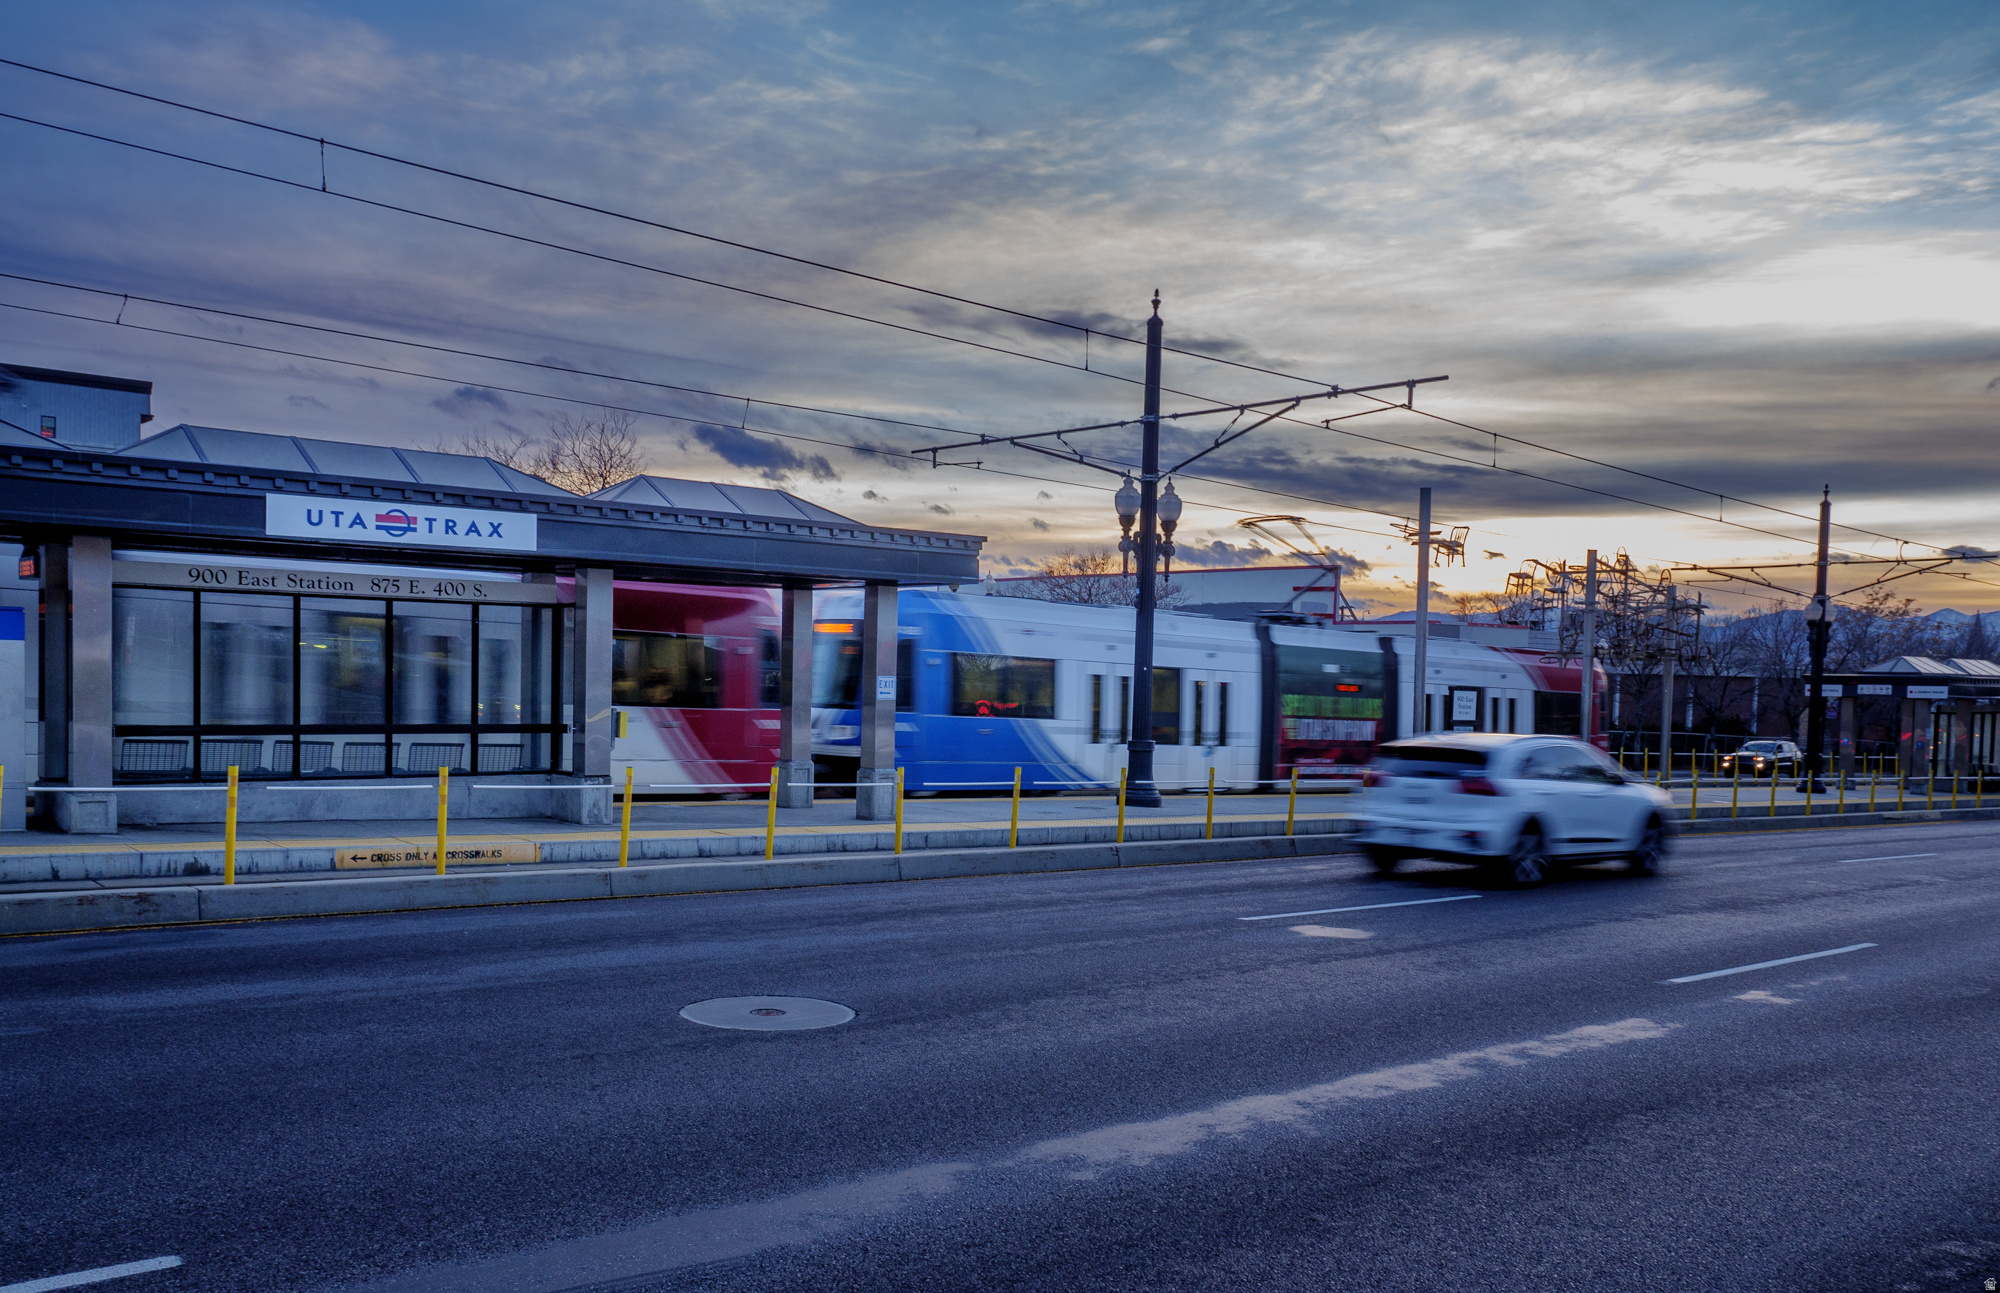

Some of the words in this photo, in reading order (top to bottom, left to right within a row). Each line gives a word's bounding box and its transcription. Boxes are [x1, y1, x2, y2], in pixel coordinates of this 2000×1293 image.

[306, 508, 368, 530] UTA
[424, 517, 504, 538] TRAX
[188, 567, 228, 585] 900
[237, 570, 278, 588] East
[286, 573, 354, 591] Station
[370, 577, 400, 593] 875
[408, 579, 426, 594] E.
[433, 581, 466, 597] 400
[473, 583, 488, 598] S.
[879, 680, 894, 688] EXIT
[370, 852, 402, 863] CROSS
[405, 851, 429, 861] ONLY
[445, 850, 502, 859] CROSSWALKS
